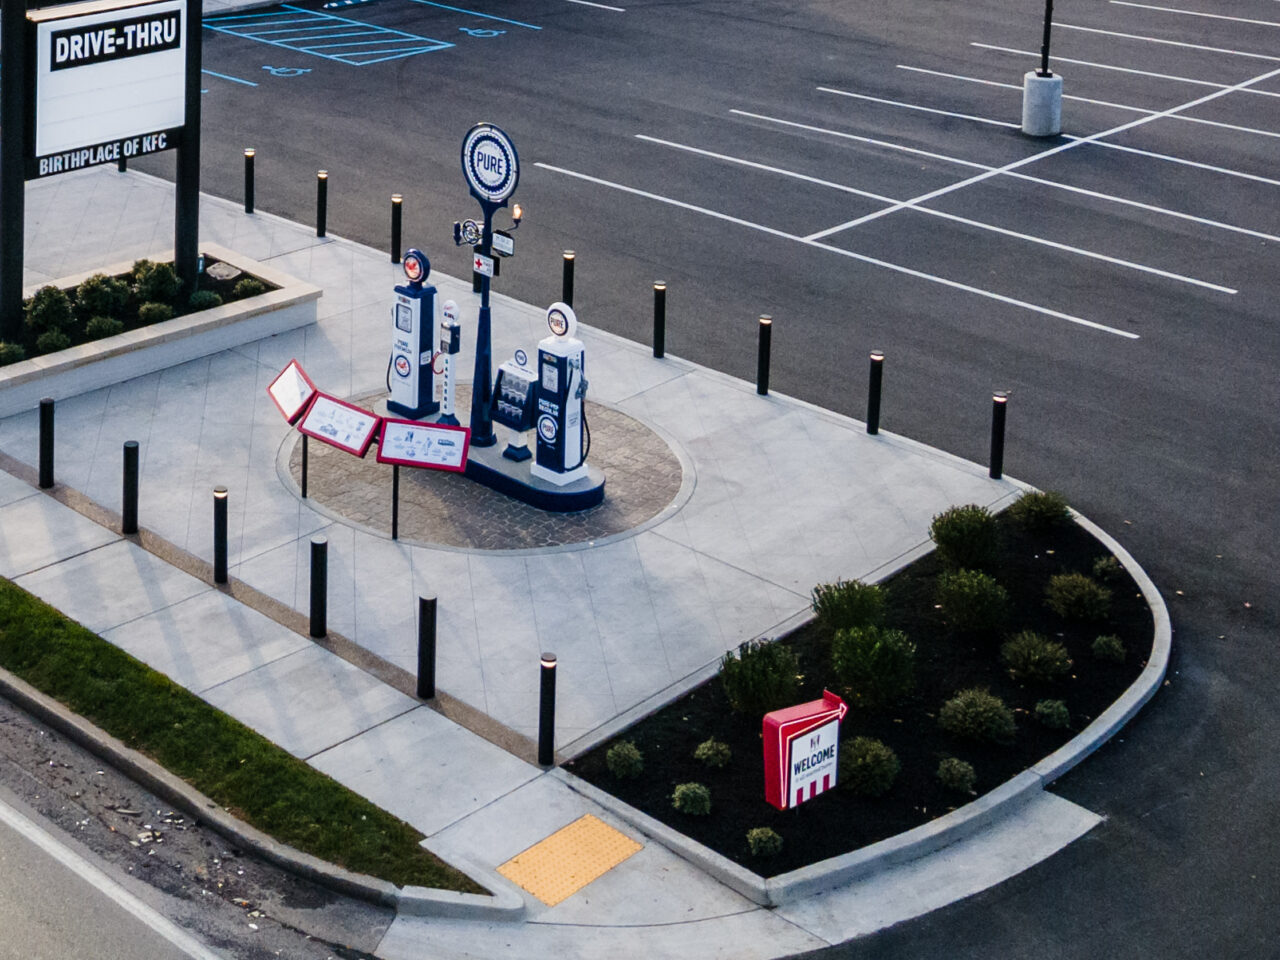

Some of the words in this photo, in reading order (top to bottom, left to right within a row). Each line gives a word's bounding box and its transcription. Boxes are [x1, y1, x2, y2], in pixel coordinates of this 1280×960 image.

[56, 18, 176, 63] DRIVE-THRU
[39, 142, 120, 175] BIRTHPLACE
[123, 138, 139, 156] OF
[142, 133, 167, 152] KFC
[477, 151, 503, 175] PURE
[550, 316, 564, 329] PURE
[793, 744, 835, 776] WELCOME
